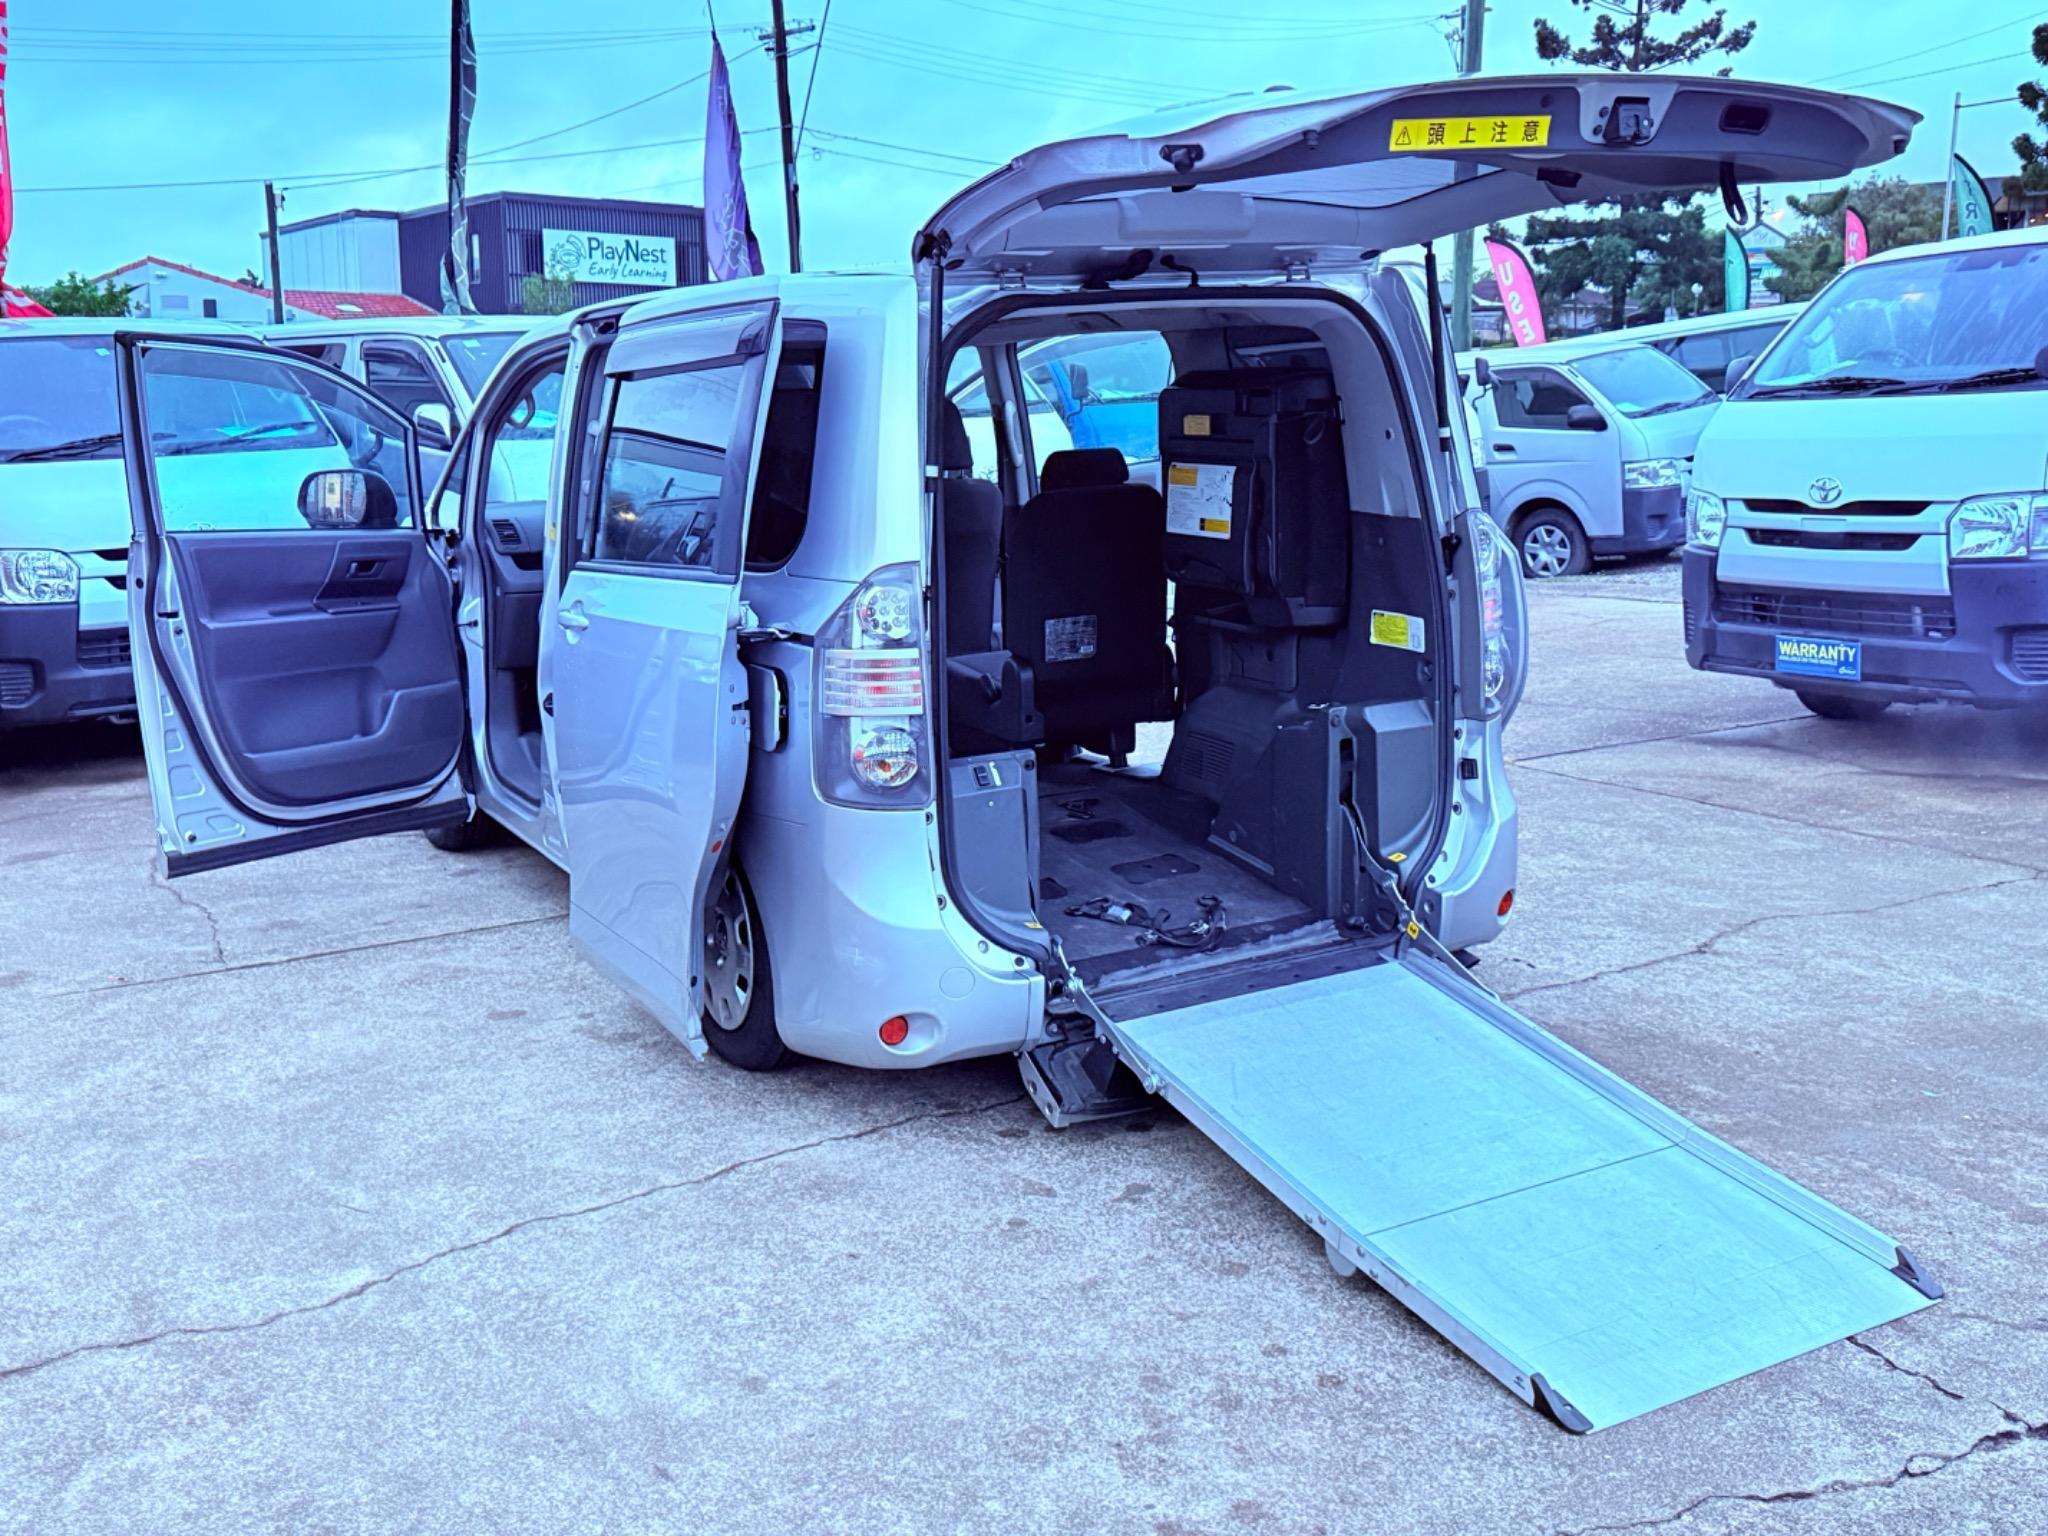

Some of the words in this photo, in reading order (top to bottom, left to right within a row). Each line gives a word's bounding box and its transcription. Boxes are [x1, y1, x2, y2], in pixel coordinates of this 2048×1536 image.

[1427, 120, 1540, 145] 頭上注意
[587, 236, 667, 266] PlayNest
[588, 262, 619, 280] Early
[622, 263, 668, 282] Learning
[1779, 640, 1856, 662] WARRANTY
